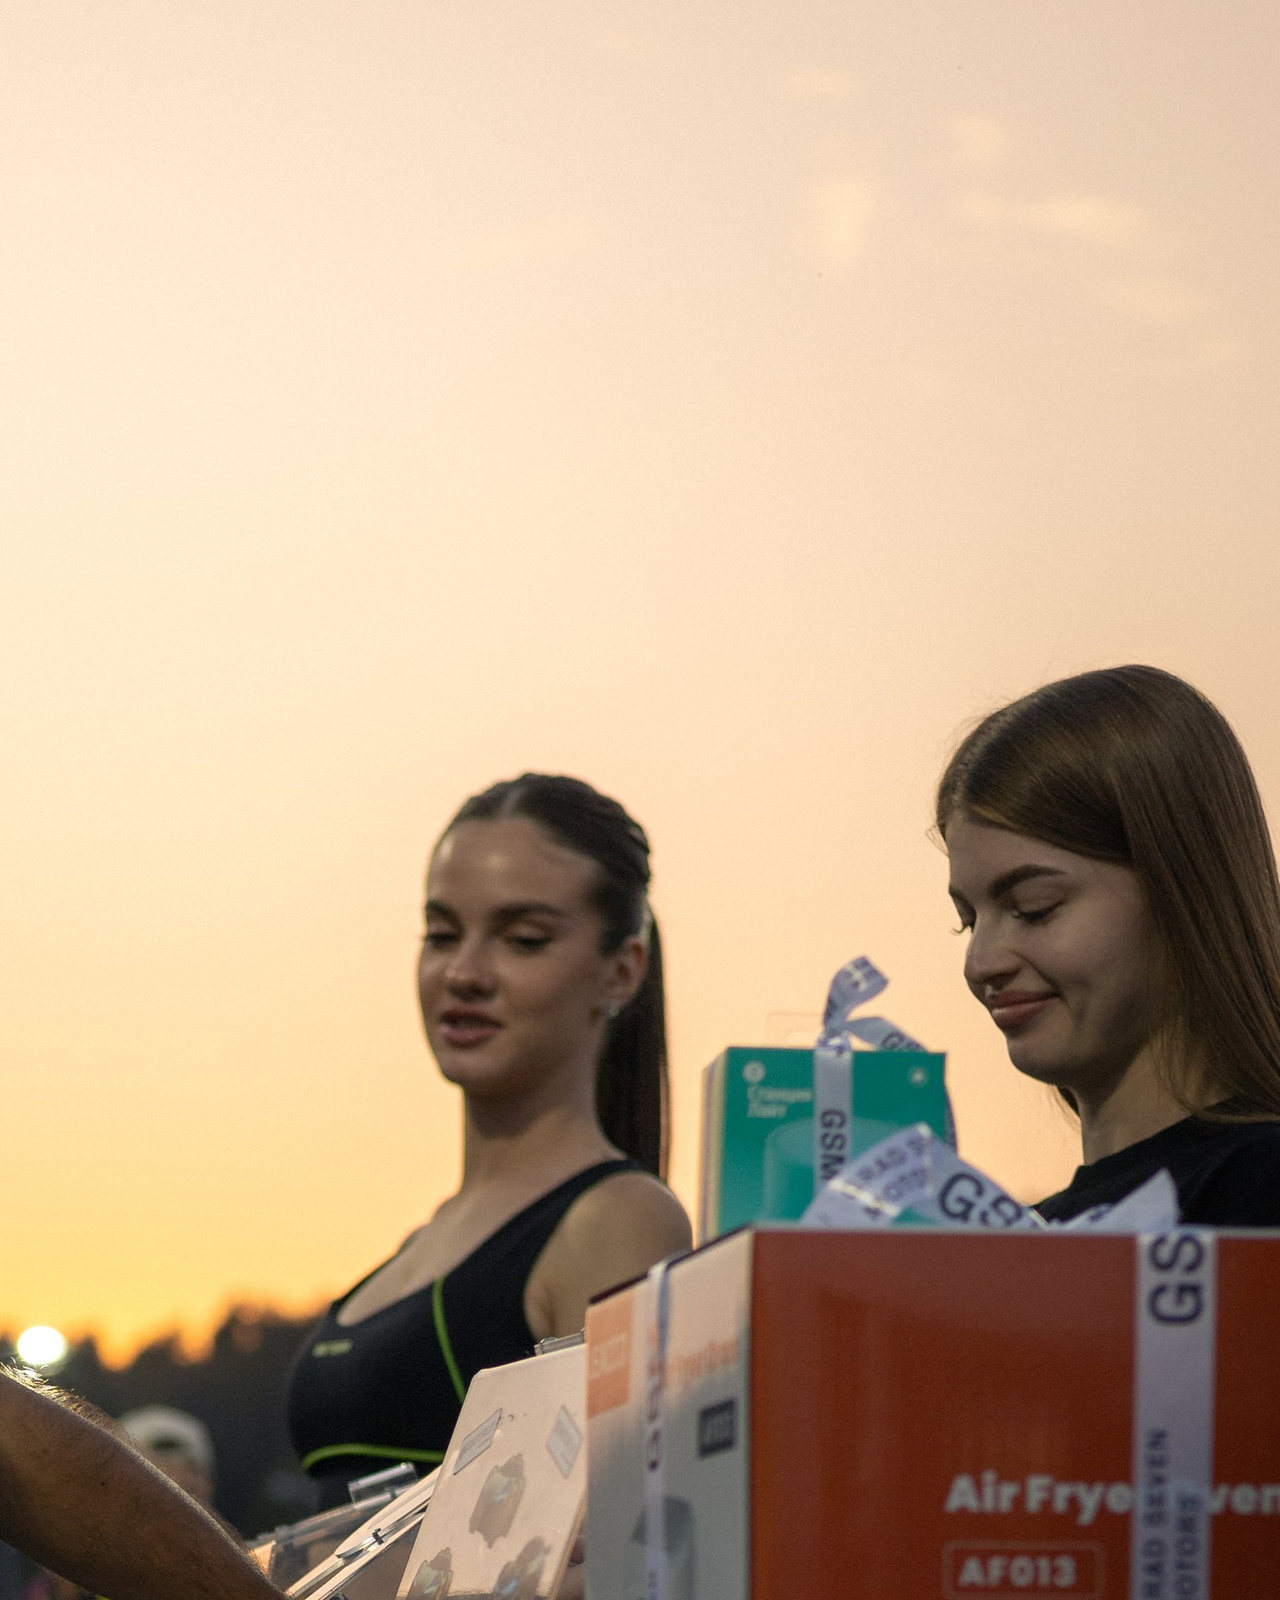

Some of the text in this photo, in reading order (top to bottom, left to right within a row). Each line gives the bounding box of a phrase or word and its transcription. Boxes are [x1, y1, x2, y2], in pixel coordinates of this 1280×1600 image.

[821, 1109, 847, 1180] GSM
[938, 1172, 1024, 1227] GS
[1149, 1234, 1204, 1327] GS
[1025, 1475, 1131, 1525] Frye
[1204, 1482, 1280, 1516] ven
[1143, 1429, 1169, 1528] SEVEN
[959, 1556, 1076, 1587] AF013
